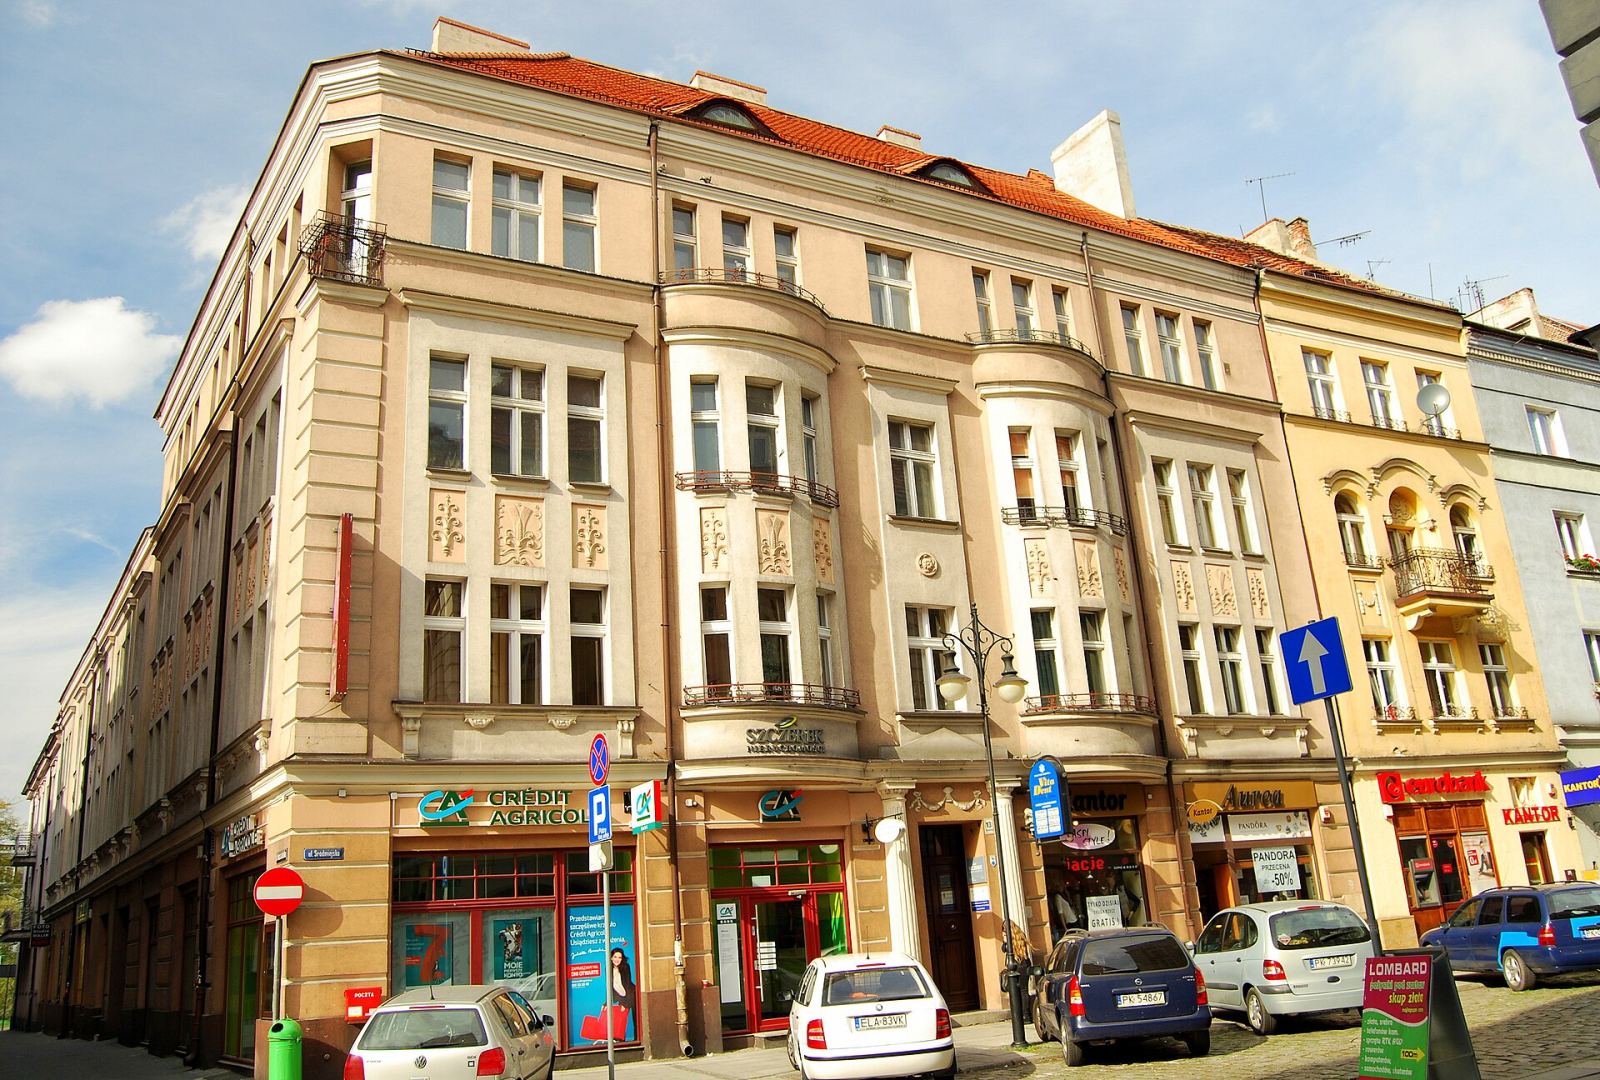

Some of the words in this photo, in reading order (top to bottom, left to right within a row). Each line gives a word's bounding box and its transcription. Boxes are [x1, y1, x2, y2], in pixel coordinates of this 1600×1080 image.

[488, 788, 573, 806] CRÉDIT
[1070, 790, 1127, 811] antor
[1223, 784, 1284, 809] Aurea
[490, 808, 590, 826] AGRICOL
[593, 793, 606, 836] P
[1193, 807, 1213, 817] Kantor
[1502, 806, 1560, 825] KANTOR
[1253, 850, 1295, 862] PANDORA
[1261, 863, 1290, 871] PRZECENA
[1271, 872, 1294, 886] -50%
[503, 961, 523, 969] MOJE
[1369, 961, 1427, 976] LOMBARD
[354, 991, 374, 999] POCZTA
[1122, 995, 1134, 1004] PK
[1136, 993, 1163, 1004] 54867
[1388, 992, 1406, 1006] skup
